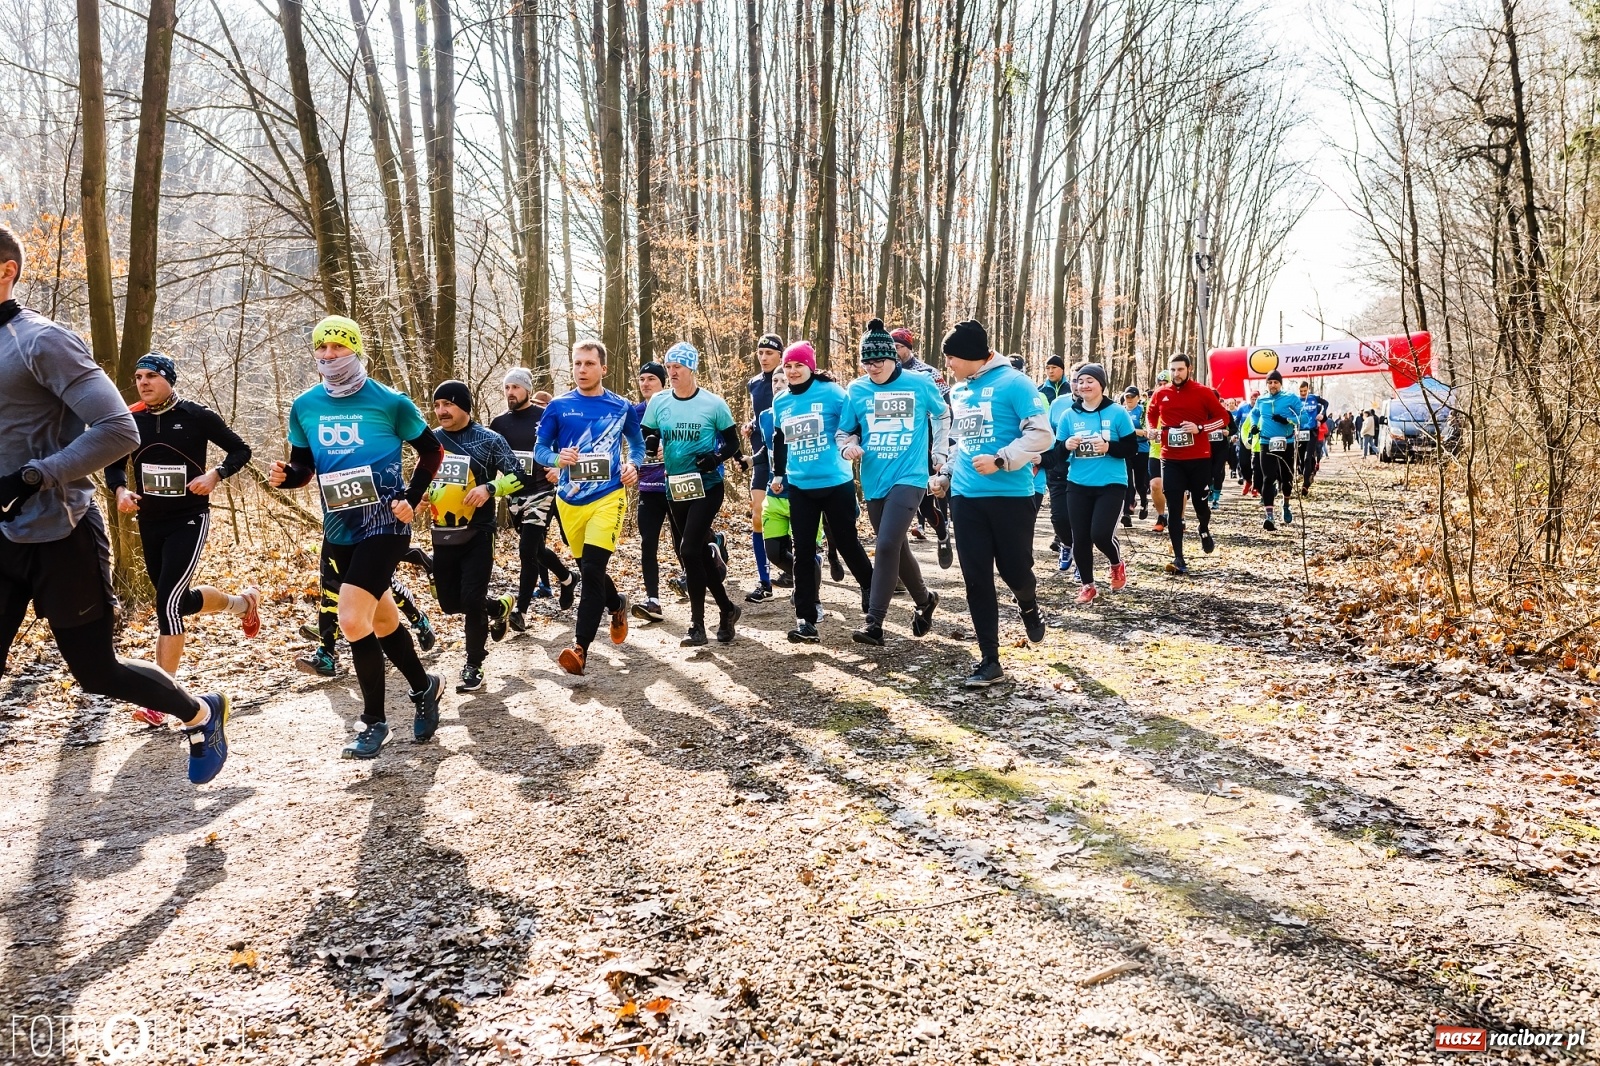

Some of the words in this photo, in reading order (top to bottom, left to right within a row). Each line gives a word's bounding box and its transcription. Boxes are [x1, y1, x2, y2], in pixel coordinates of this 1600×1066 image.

[324, 329, 347, 339] XYZ
[1285, 352, 1350, 363] TWARDZIELA
[1292, 362, 1344, 373] RACIBÓRZ
[882, 400, 907, 411] 038
[792, 423, 811, 434] 134
[957, 417, 976, 430] 005
[318, 422, 364, 446] bbl
[663, 430, 700, 442] RUNNING
[868, 433, 913, 446] BIEG
[1171, 433, 1188, 442] 083
[798, 453, 819, 462] 2022
[579, 462, 599, 474] 115
[154, 475, 171, 488] 111
[675, 481, 696, 494] 006
[333, 481, 363, 499] 138
